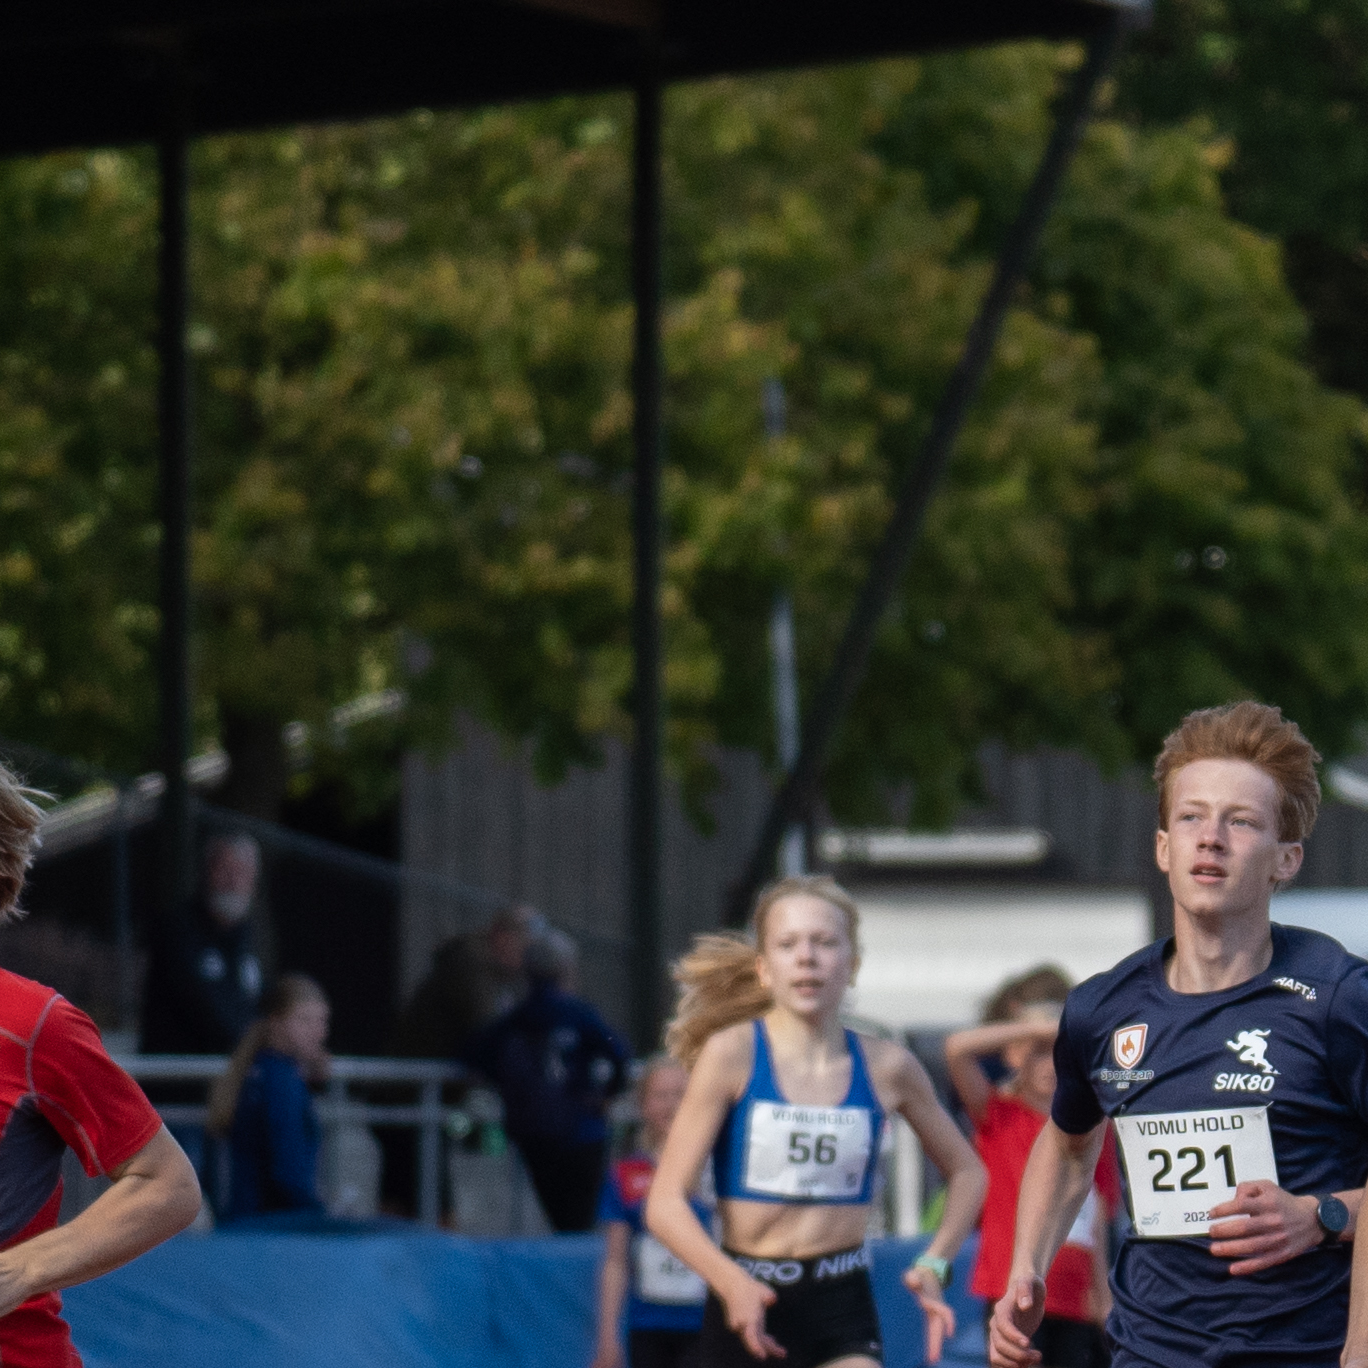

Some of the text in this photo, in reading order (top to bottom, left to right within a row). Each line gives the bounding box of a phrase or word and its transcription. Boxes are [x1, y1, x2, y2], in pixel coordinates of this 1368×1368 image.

[1272, 977, 1311, 995] RAFT
[1214, 1072, 1275, 1092] SIK80
[1136, 1114, 1245, 1136] VDMU HOLD
[788, 1131, 838, 1165] 56
[1148, 1144, 1237, 1192] 221
